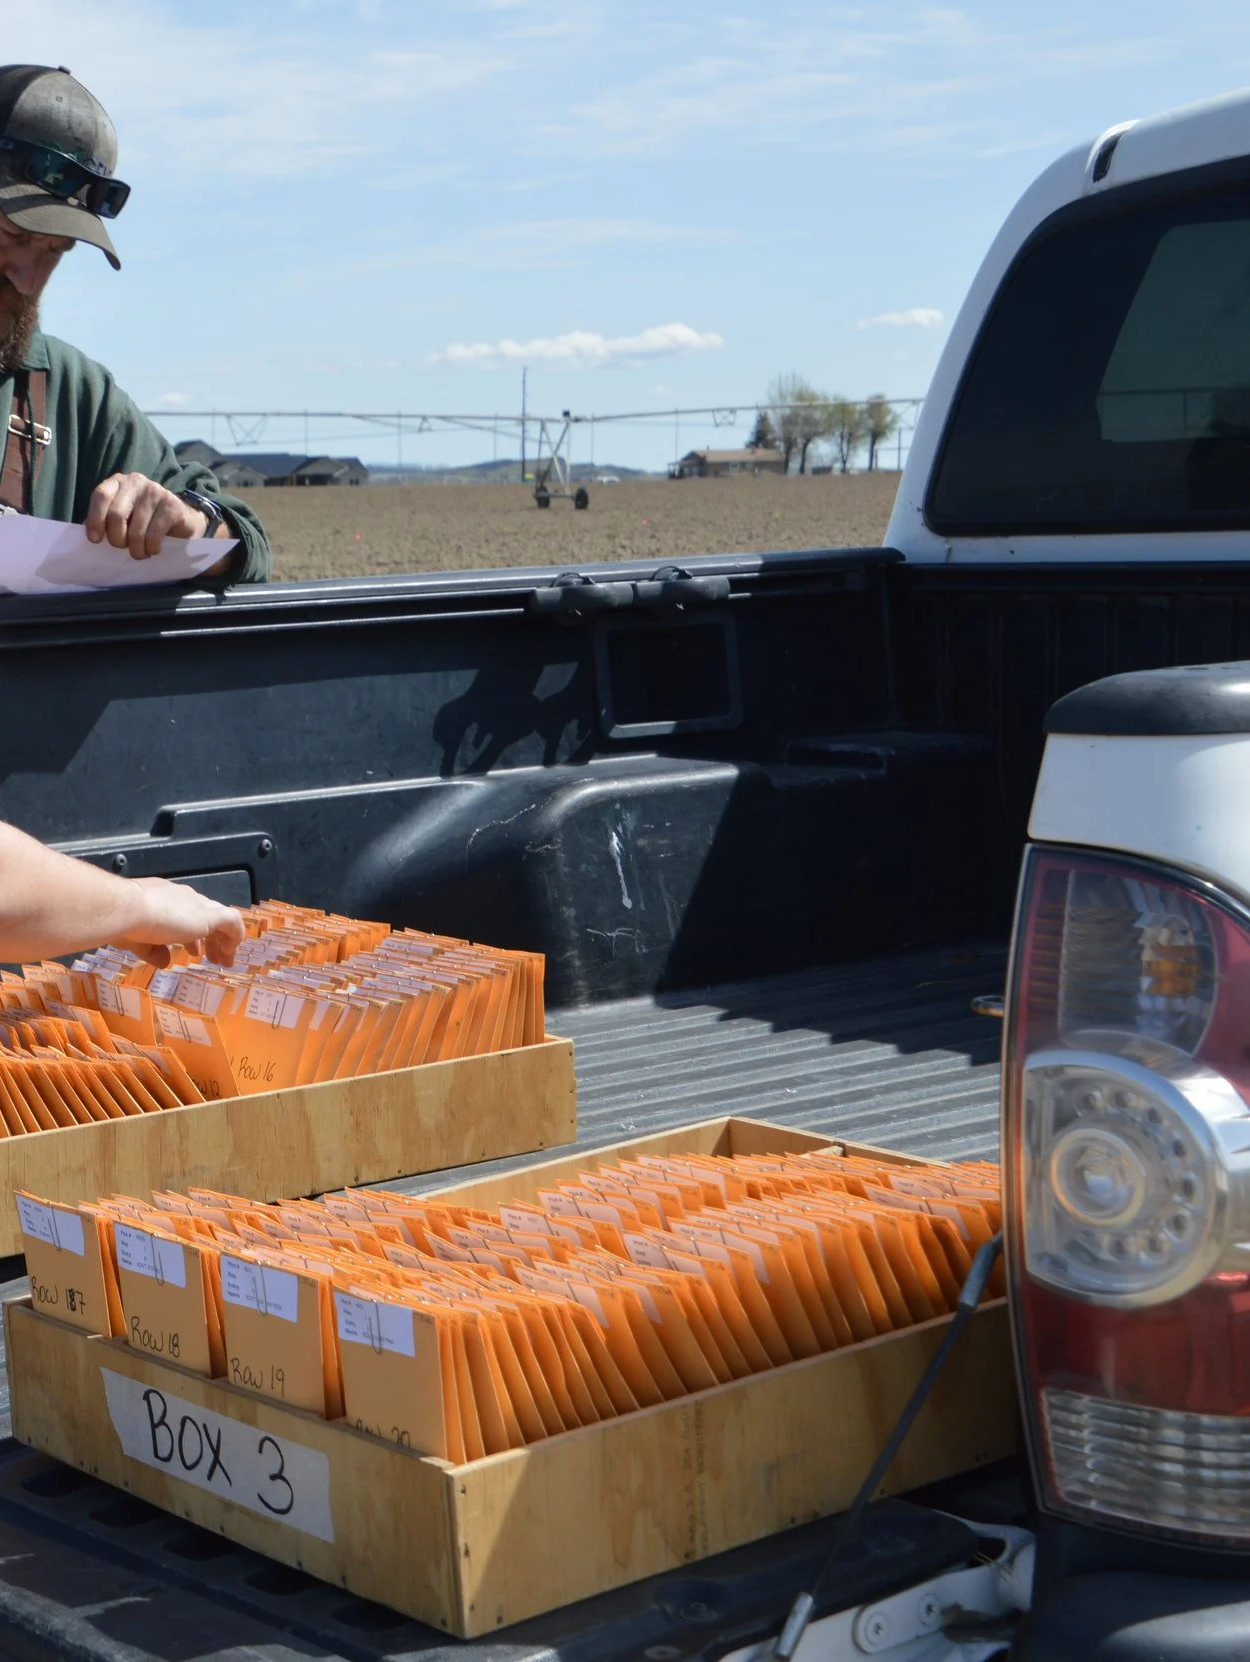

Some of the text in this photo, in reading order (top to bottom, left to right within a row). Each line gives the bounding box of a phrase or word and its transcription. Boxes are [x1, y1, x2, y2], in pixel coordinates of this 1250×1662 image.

[238, 1056, 261, 1081] Row
[263, 1060, 277, 1082] 16
[31, 1276, 58, 1304] Row
[131, 1316, 181, 1357] Row 18
[230, 1357, 284, 1397] Row 19
[143, 1389, 293, 1515] BOX 3
